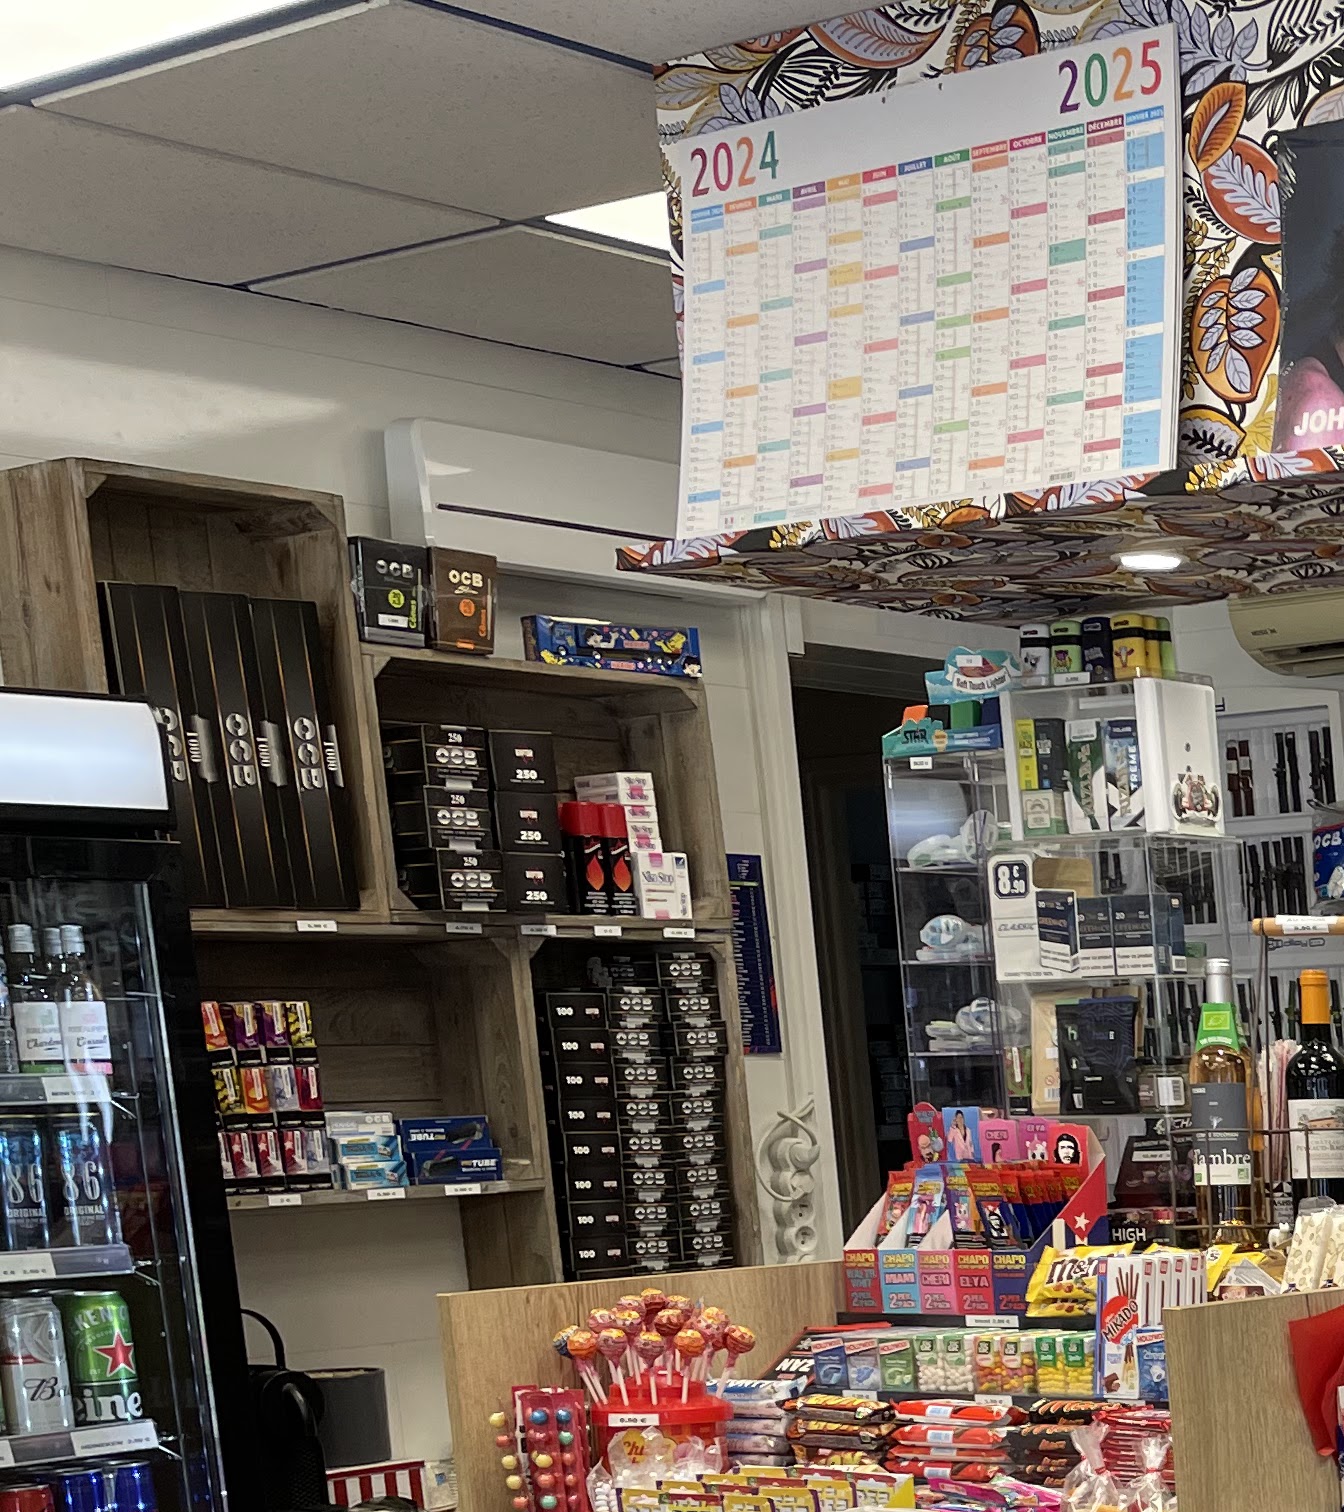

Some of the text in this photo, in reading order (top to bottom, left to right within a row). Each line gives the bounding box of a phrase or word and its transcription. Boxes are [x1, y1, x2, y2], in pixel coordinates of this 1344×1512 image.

[1059, 40, 1162, 114] 2025
[691, 131, 779, 197] 2024
[448, 569, 483, 588] OCB
[187, 732, 202, 762] 1000
[516, 769, 537, 780] 250
[520, 831, 541, 841] 250
[556, 1007, 573, 1016] 100
[1112, 1226, 1147, 1242] HIGH
[1102, 1299, 1138, 1343] MIKADO
